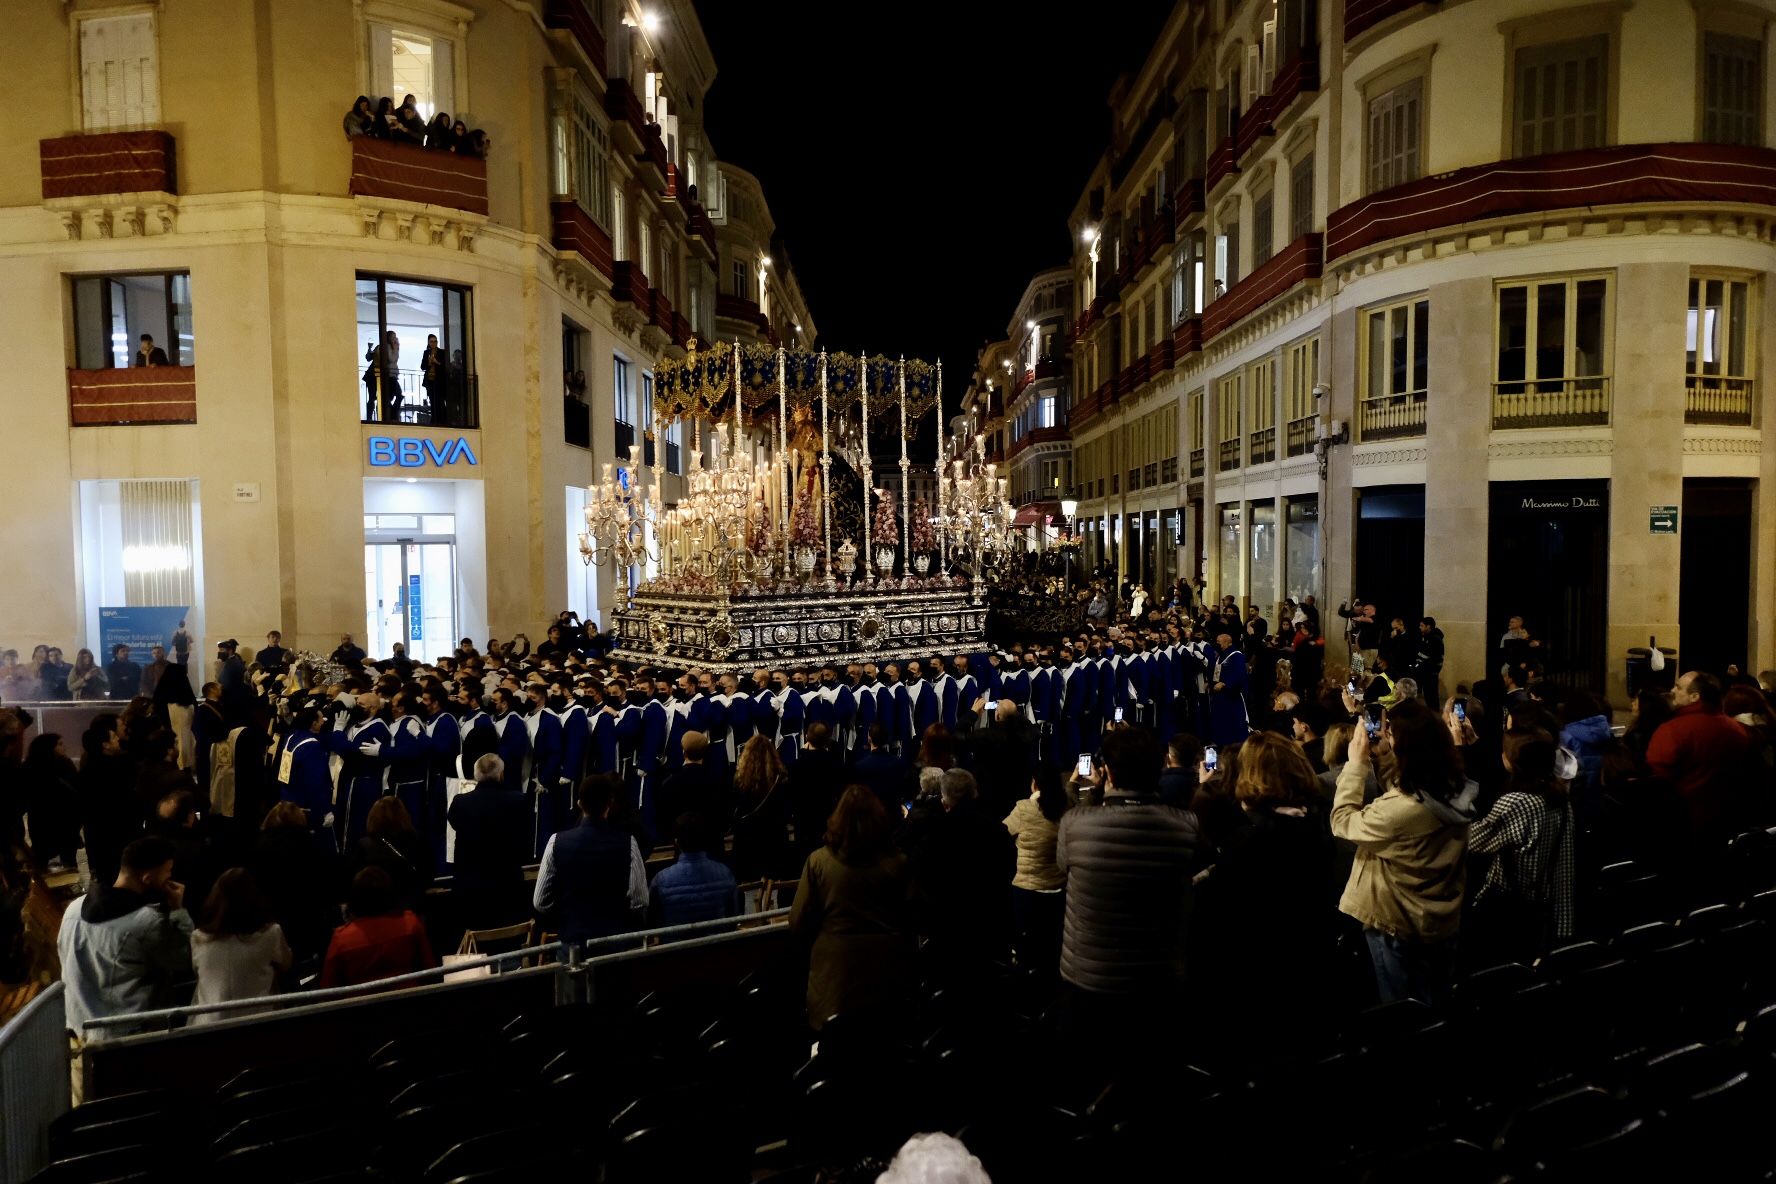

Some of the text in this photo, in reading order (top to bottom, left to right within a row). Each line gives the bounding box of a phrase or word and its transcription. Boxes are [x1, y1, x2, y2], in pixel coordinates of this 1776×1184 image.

[369, 436, 478, 468] BBVA
[1521, 496, 1601, 509] Massimo Dutti
